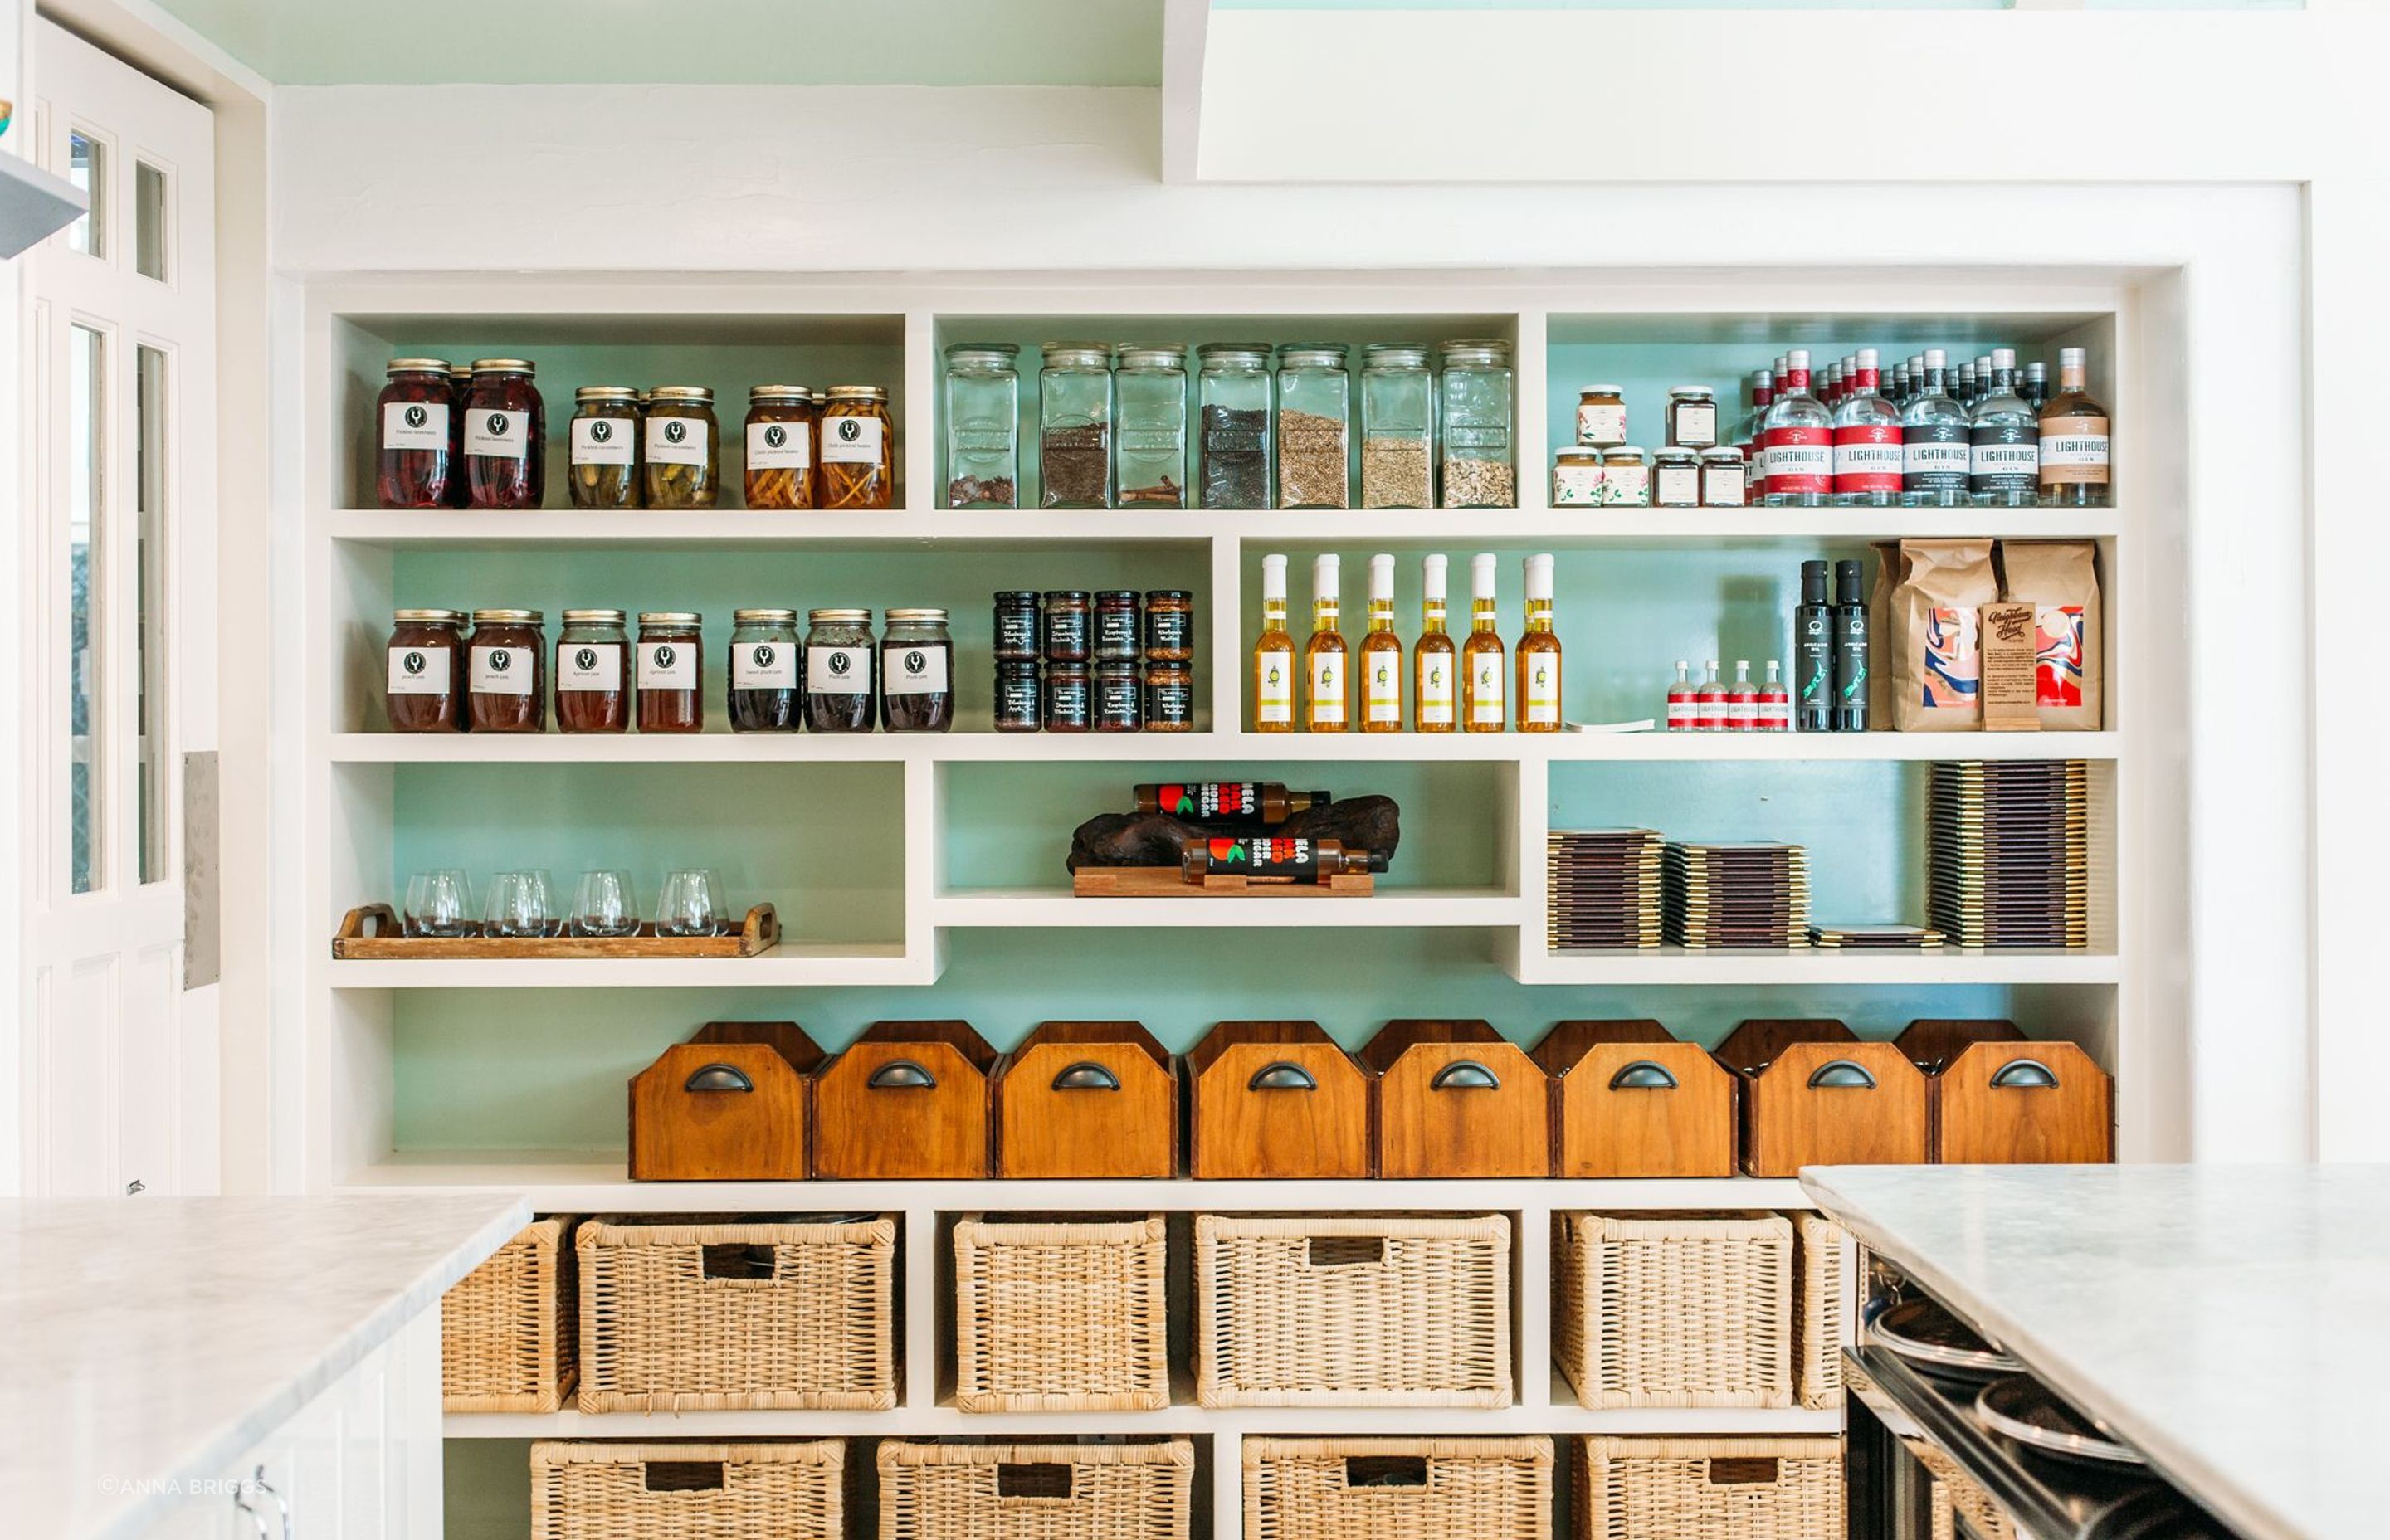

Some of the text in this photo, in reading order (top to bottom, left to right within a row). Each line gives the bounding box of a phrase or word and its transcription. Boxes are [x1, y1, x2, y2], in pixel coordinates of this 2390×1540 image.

[2056, 441, 2108, 452] LIGHTHOUSE
[1769, 451, 1824, 463] LIGHTHOUSE
[1848, 450, 1901, 461] LIGHTHOUSE
[1913, 449, 1967, 461] LIGHTHOUSE
[1981, 451, 2035, 462] LIGHTHOUSE
[1295, 839, 1309, 864] ELA
